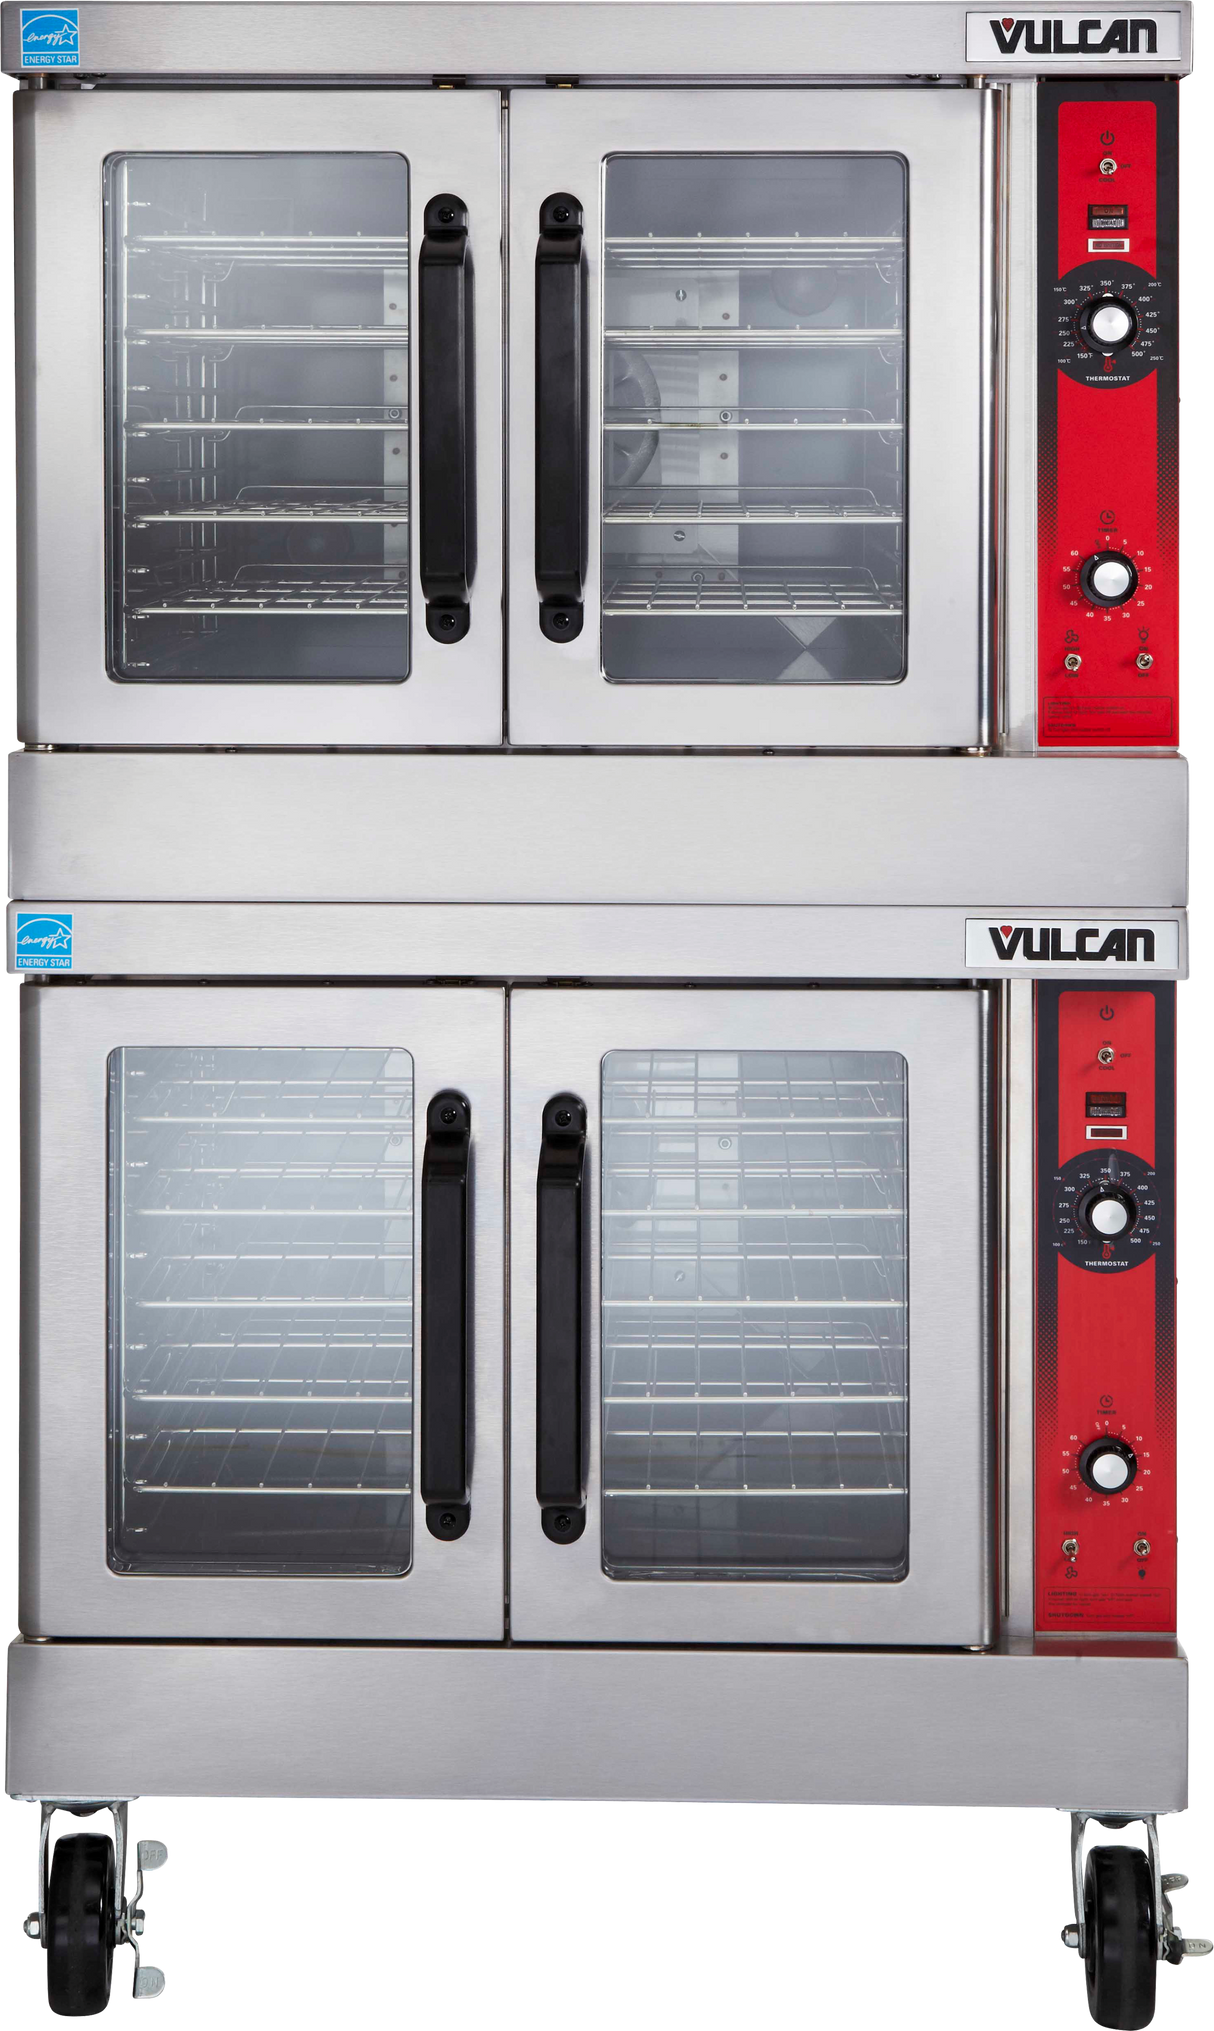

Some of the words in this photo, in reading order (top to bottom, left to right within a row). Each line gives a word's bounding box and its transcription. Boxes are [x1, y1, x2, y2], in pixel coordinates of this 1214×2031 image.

[989, 18, 1158, 54] VULCAN
[57, 55, 77, 63] STAR
[988, 926, 1155, 962] VULCAN
[18, 958, 49, 966] ENERGY
[50, 959, 70, 967] STAR
